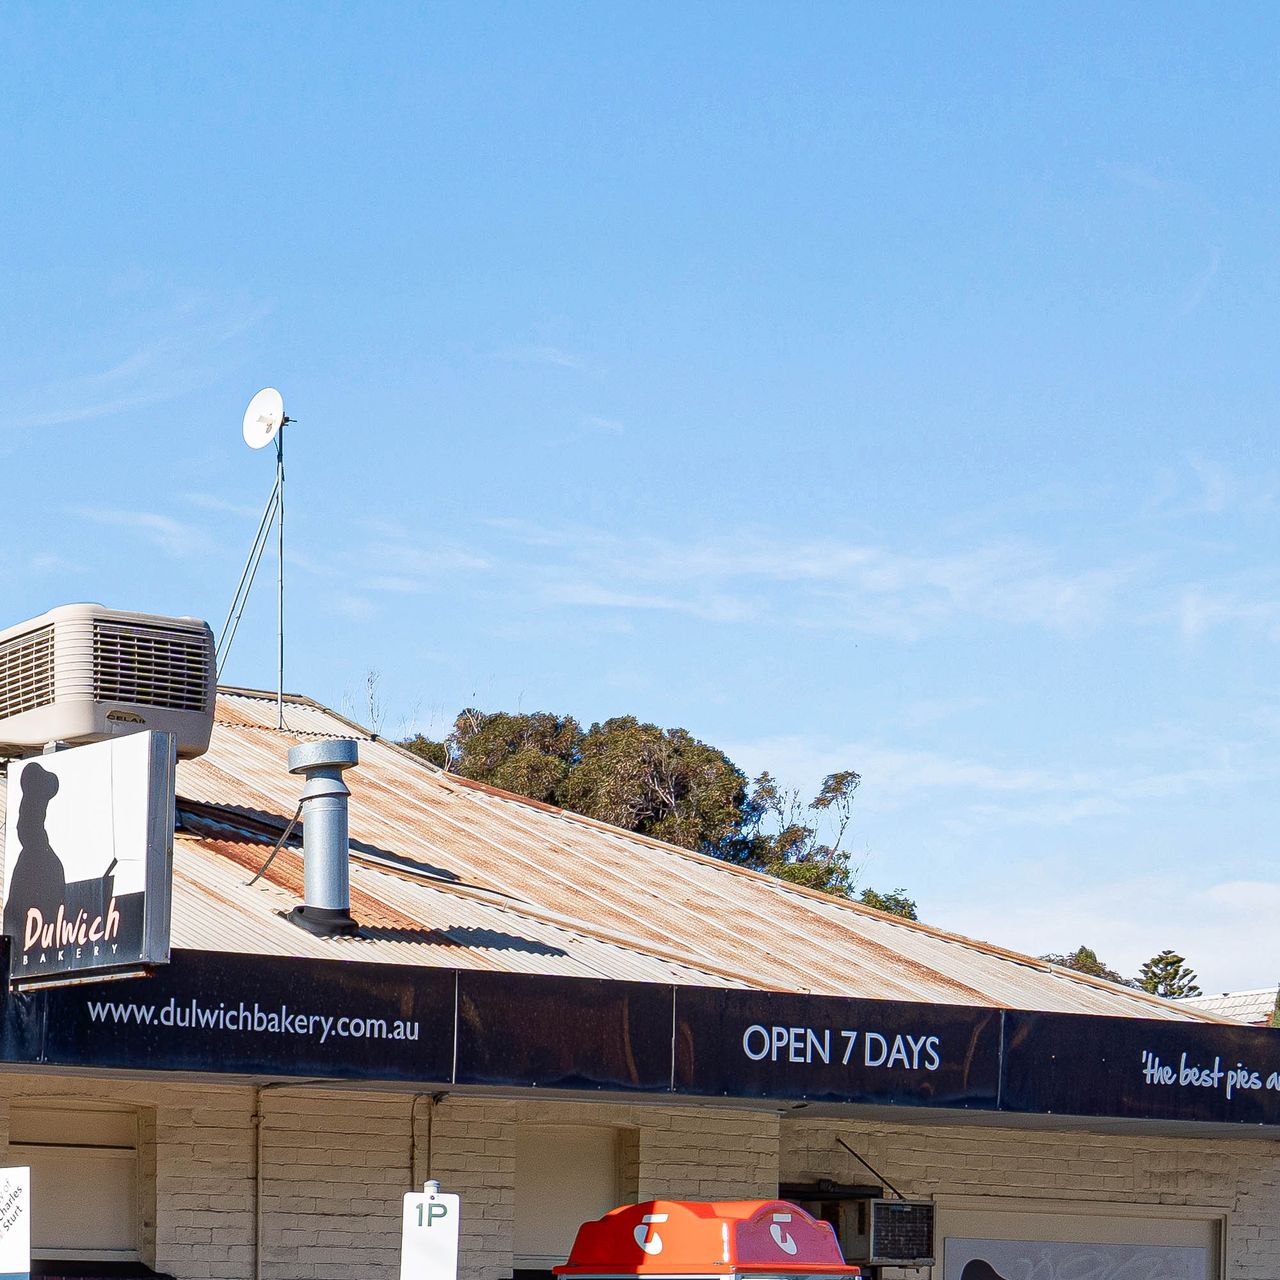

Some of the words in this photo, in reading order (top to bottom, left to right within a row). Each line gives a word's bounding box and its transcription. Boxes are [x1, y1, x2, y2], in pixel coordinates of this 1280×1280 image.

[23, 897, 120, 952] Dulwich
[23, 944, 118, 965] BAKERY
[86, 997, 420, 1044] www.dulwichbakery.com.au
[742, 1024, 830, 1065] OPEN
[841, 1030, 857, 1066] 7
[864, 1032, 940, 1071] DAYS
[1180, 1052, 1224, 1088] best
[1226, 1063, 1262, 1100] pies
[2, 1206, 23, 1232] Sturt
[416, 1202, 448, 1227] 1P
